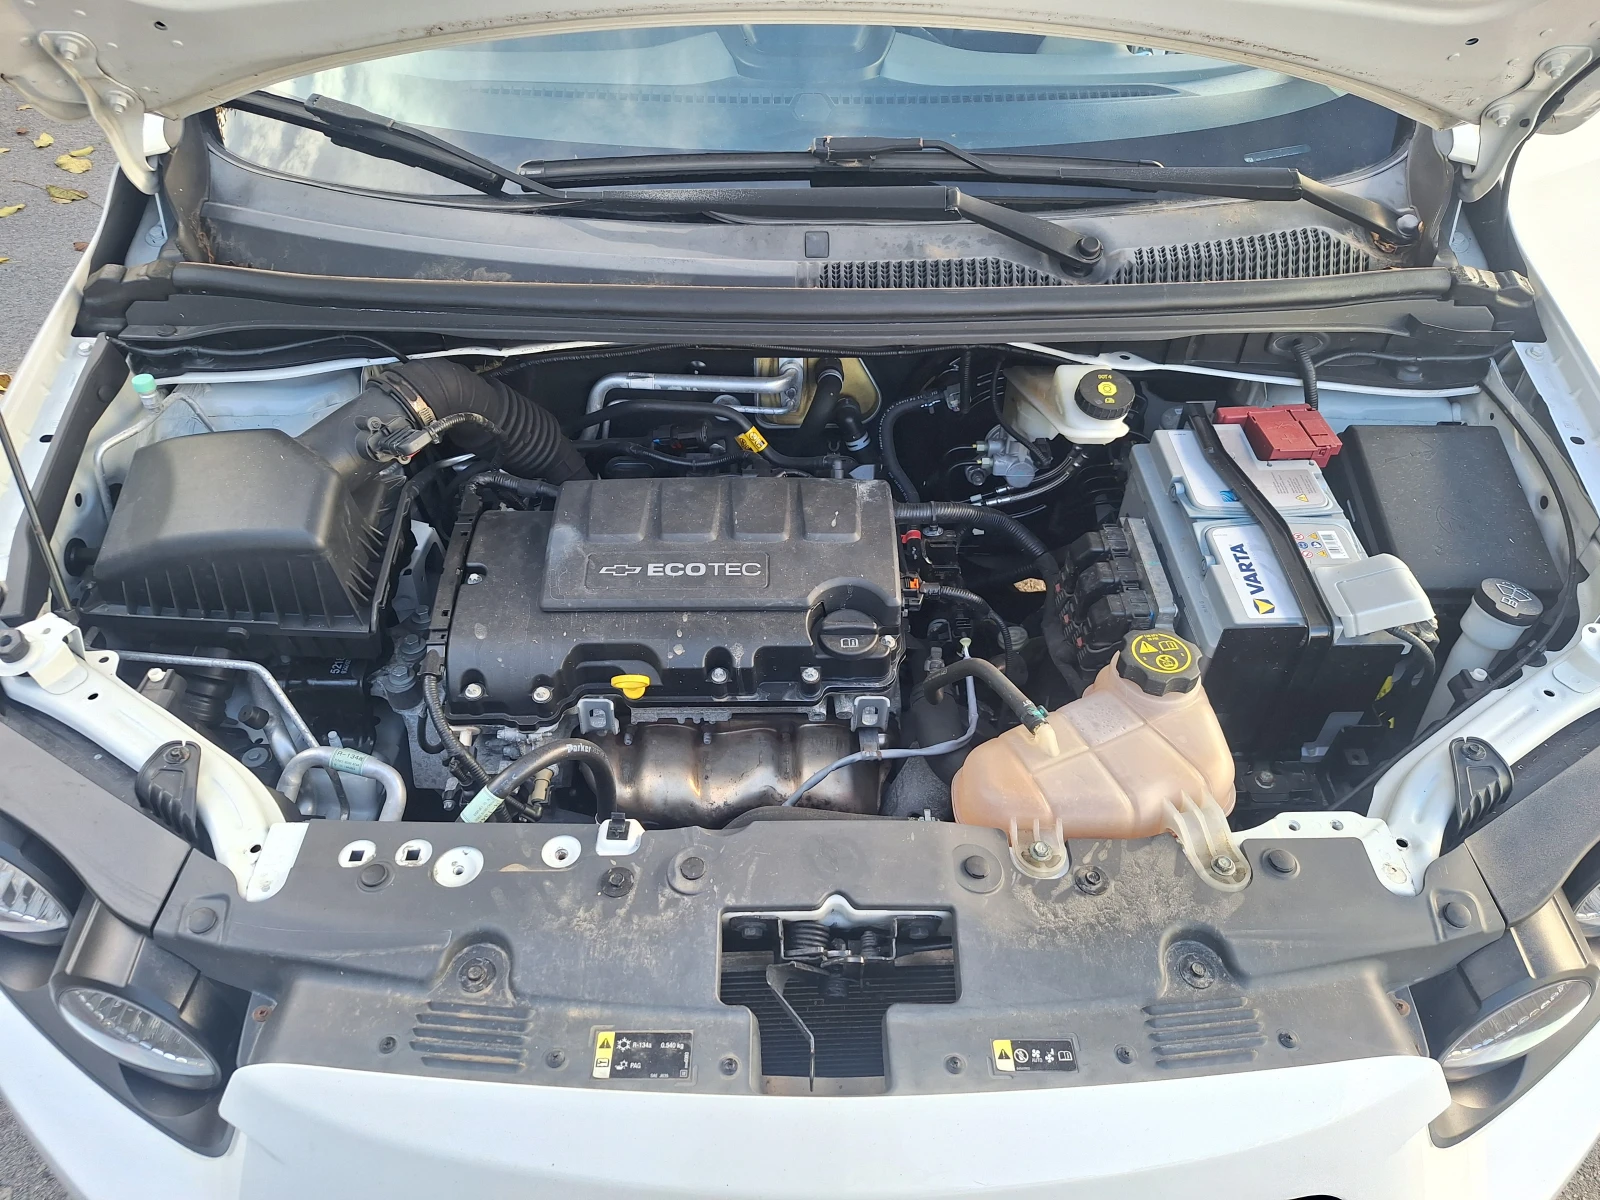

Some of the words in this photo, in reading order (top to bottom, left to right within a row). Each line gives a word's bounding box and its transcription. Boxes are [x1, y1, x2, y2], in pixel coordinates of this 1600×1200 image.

[647, 562, 761, 576] ECOTEC
[1230, 543, 1265, 595] VARTA
[566, 742, 592, 753] Parker
[632, 1041, 653, 1049] R-134a
[676, 1042, 684, 1050] kg
